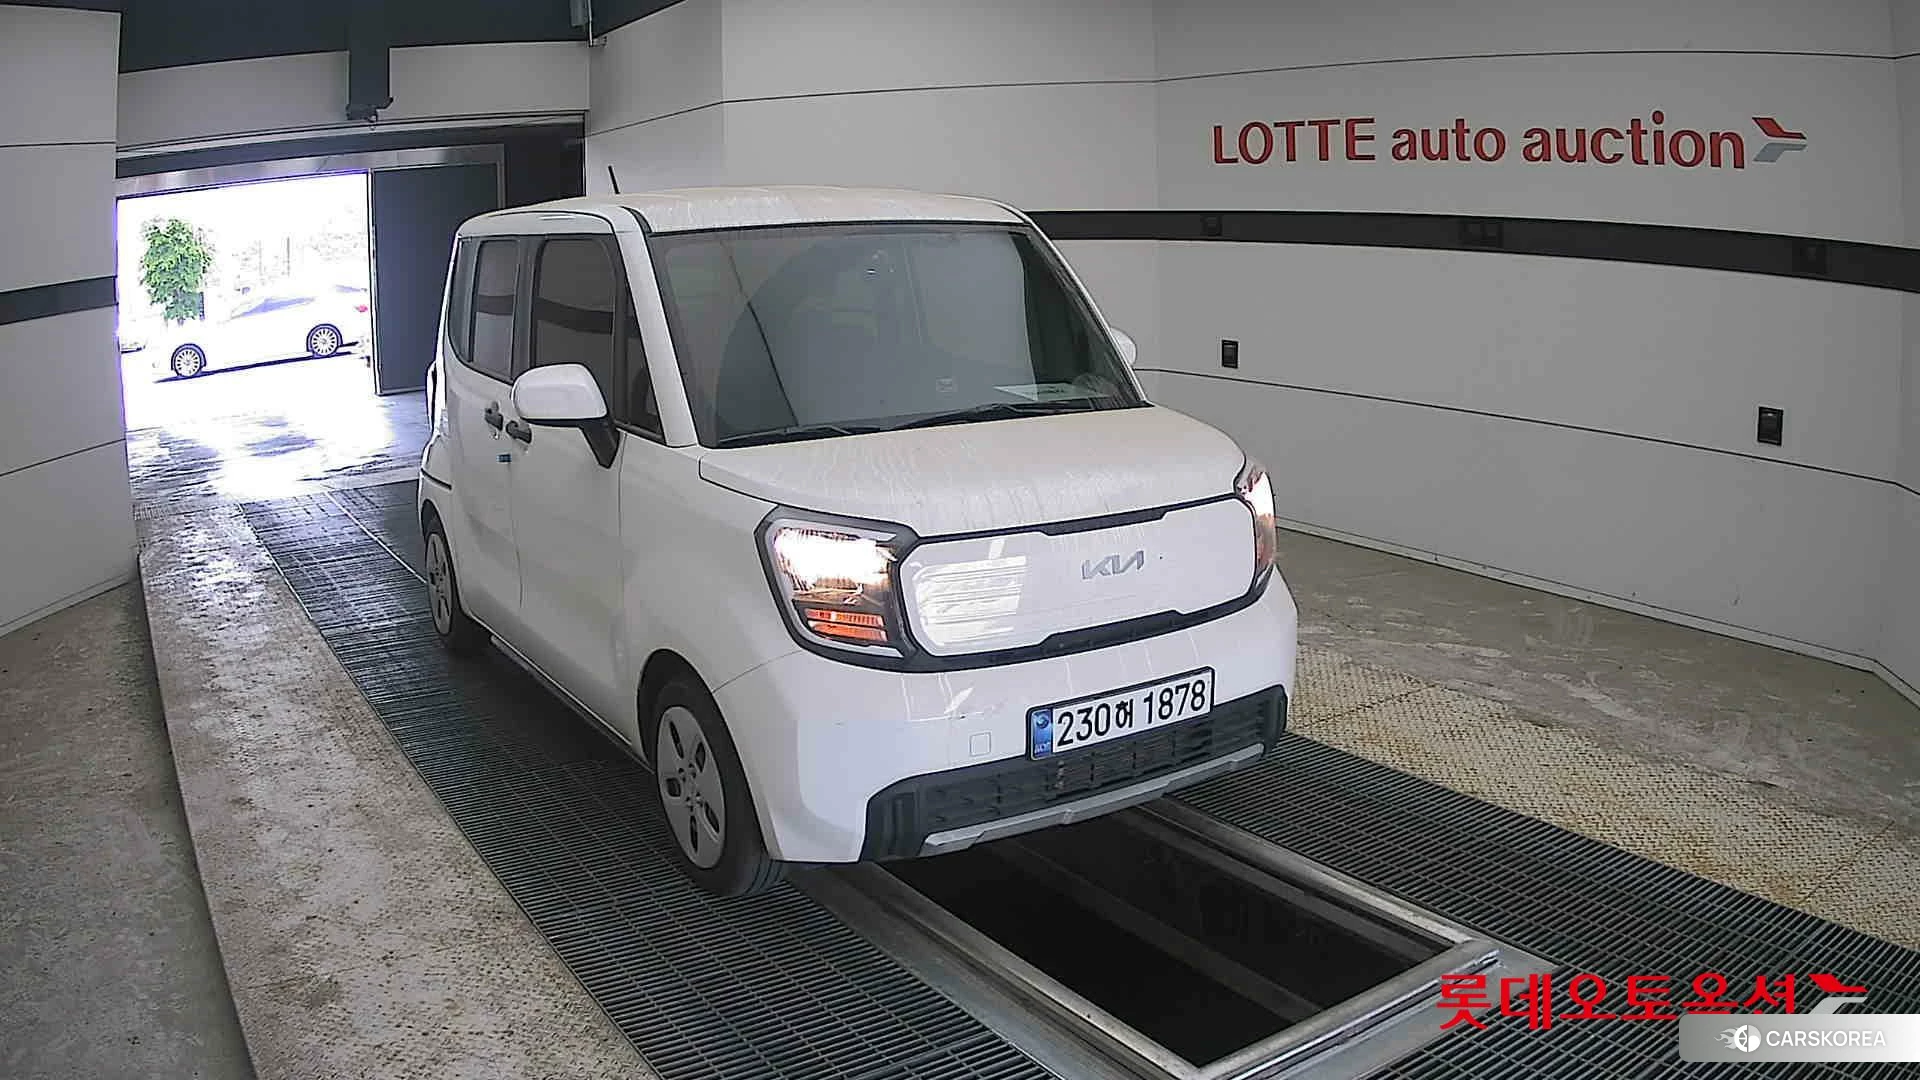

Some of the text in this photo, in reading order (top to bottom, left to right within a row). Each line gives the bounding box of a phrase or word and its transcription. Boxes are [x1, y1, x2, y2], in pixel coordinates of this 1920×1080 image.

[1213, 110, 1745, 169] LOTTE auto auction
[1081, 549, 1145, 580] KIA
[1057, 679, 1206, 747] 230허 1878
